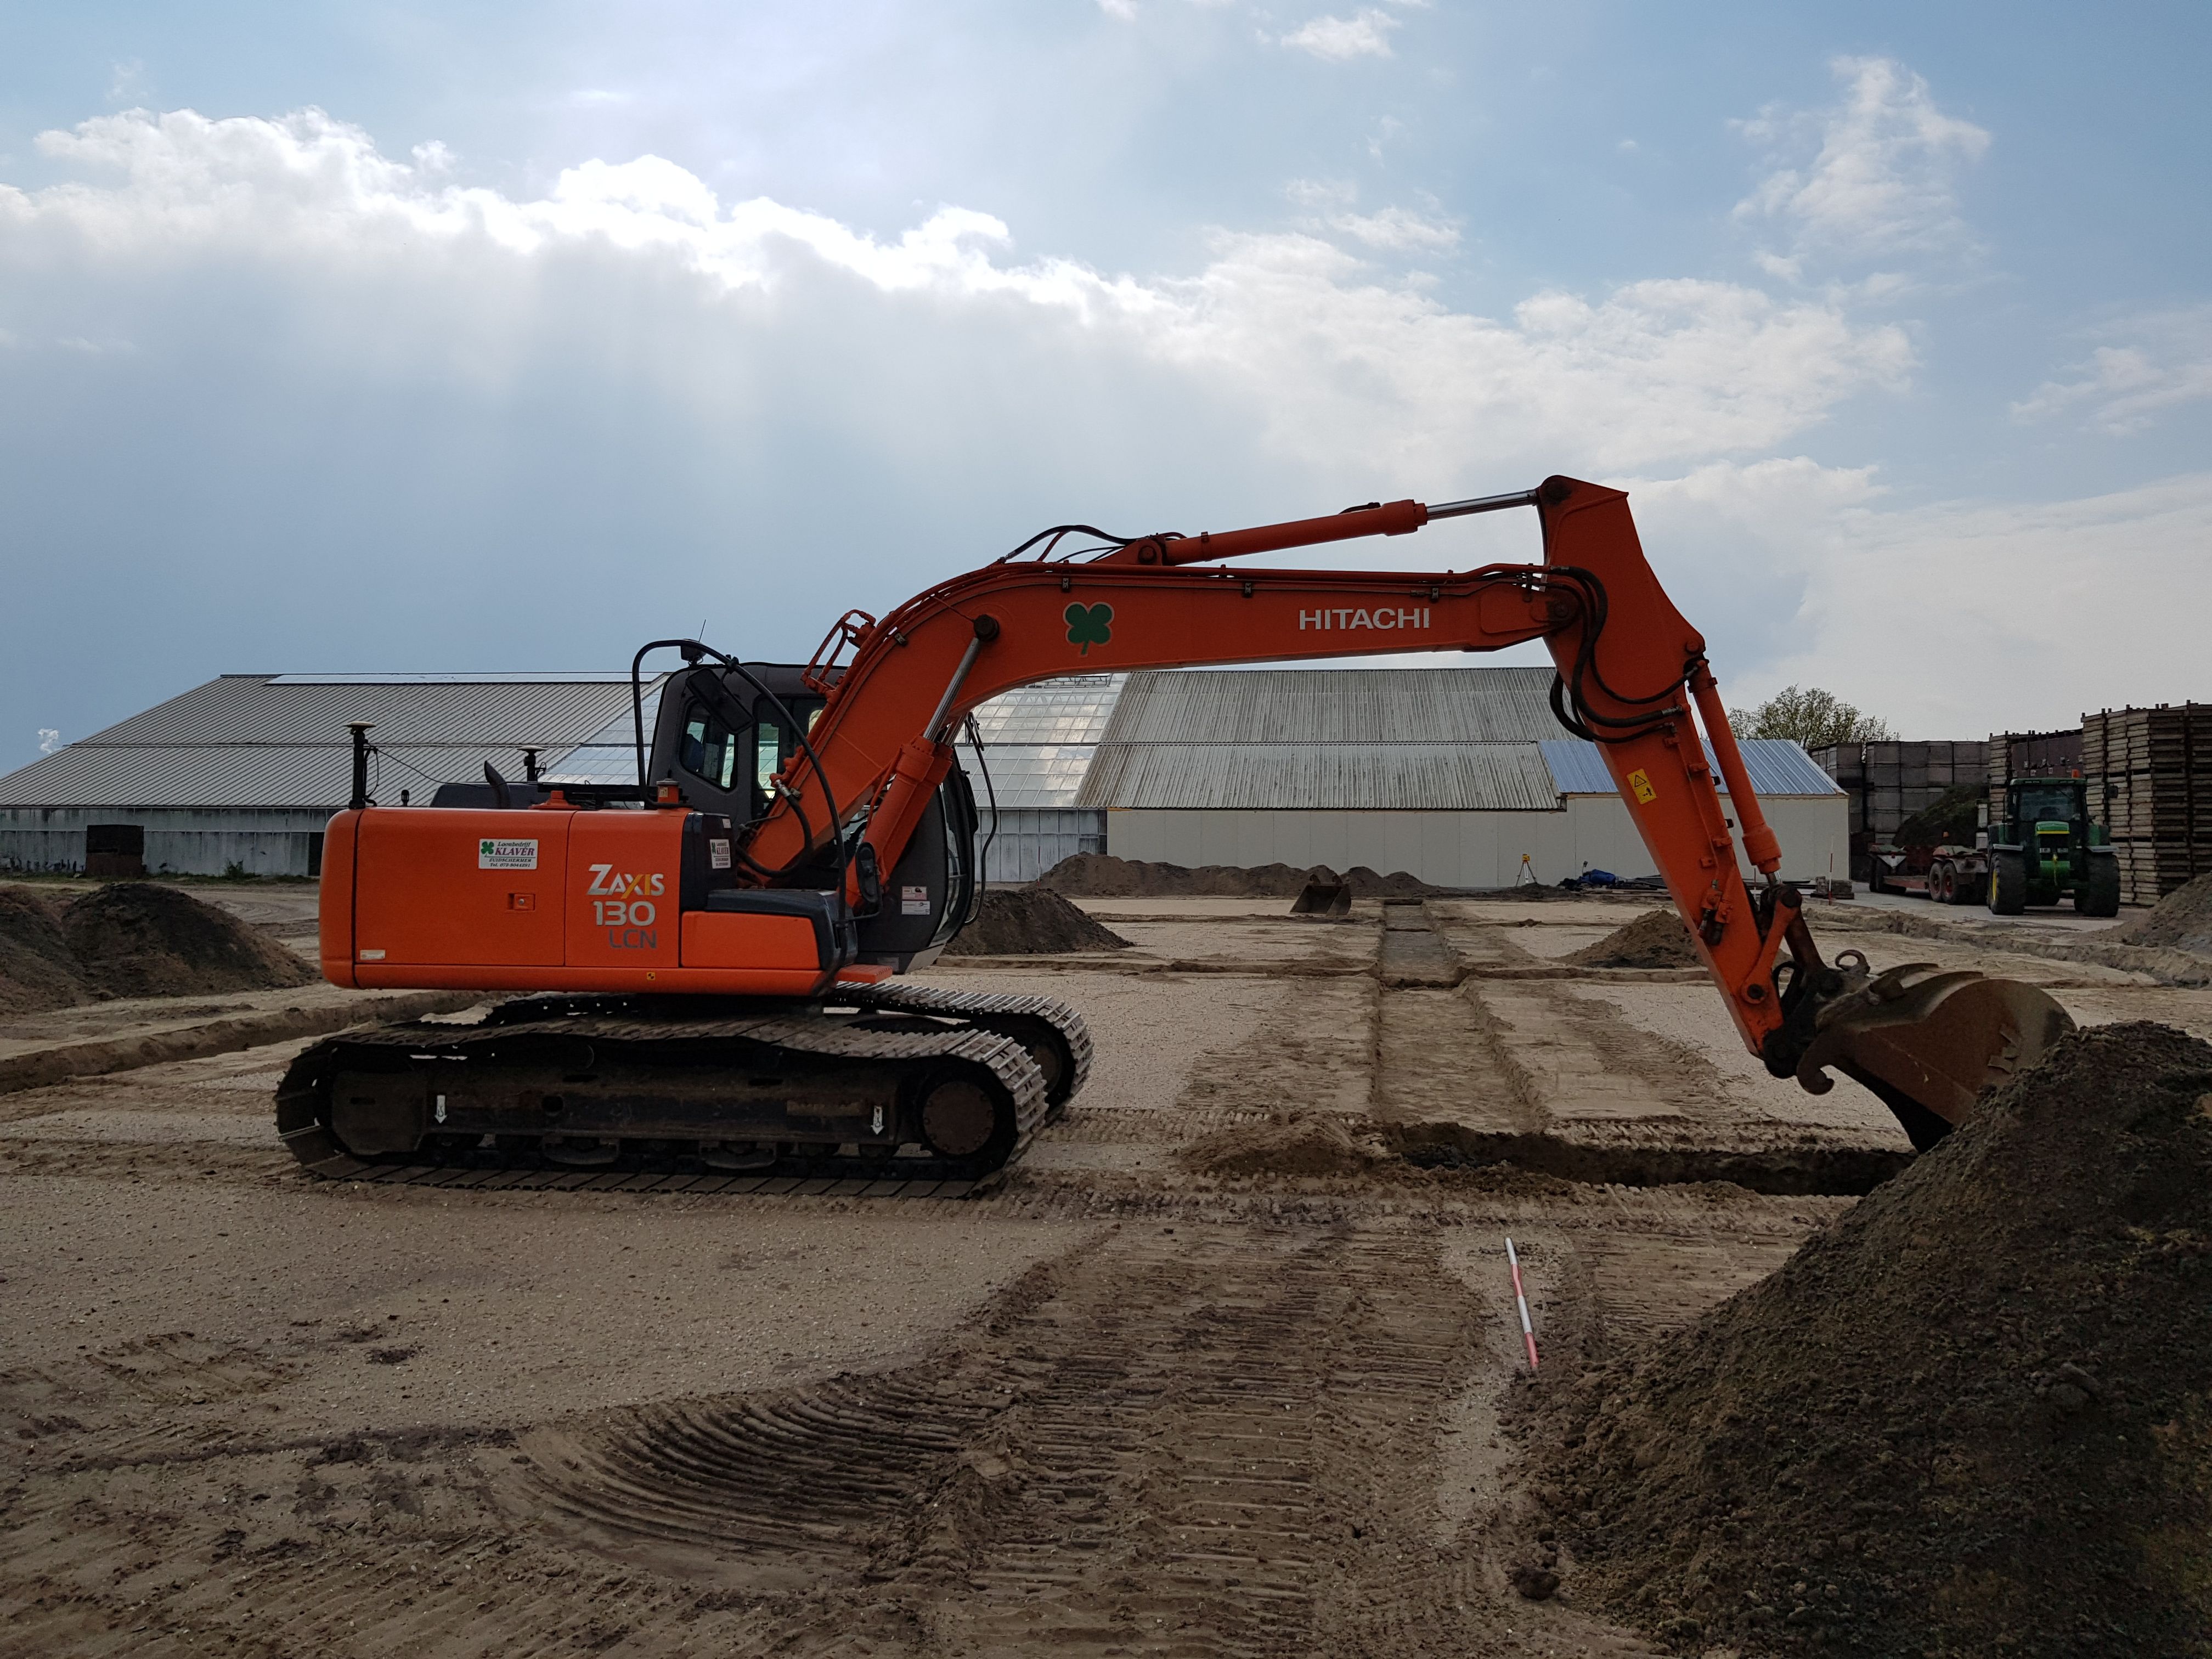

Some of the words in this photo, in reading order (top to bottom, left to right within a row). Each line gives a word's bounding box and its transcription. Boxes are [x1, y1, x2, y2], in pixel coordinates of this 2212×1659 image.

[1299, 607, 1430, 630] HITACHI
[495, 847, 535, 856] KLAVER
[586, 864, 665, 900] ZAXIS
[593, 900, 656, 927] 130
[609, 929, 657, 949] LCN
